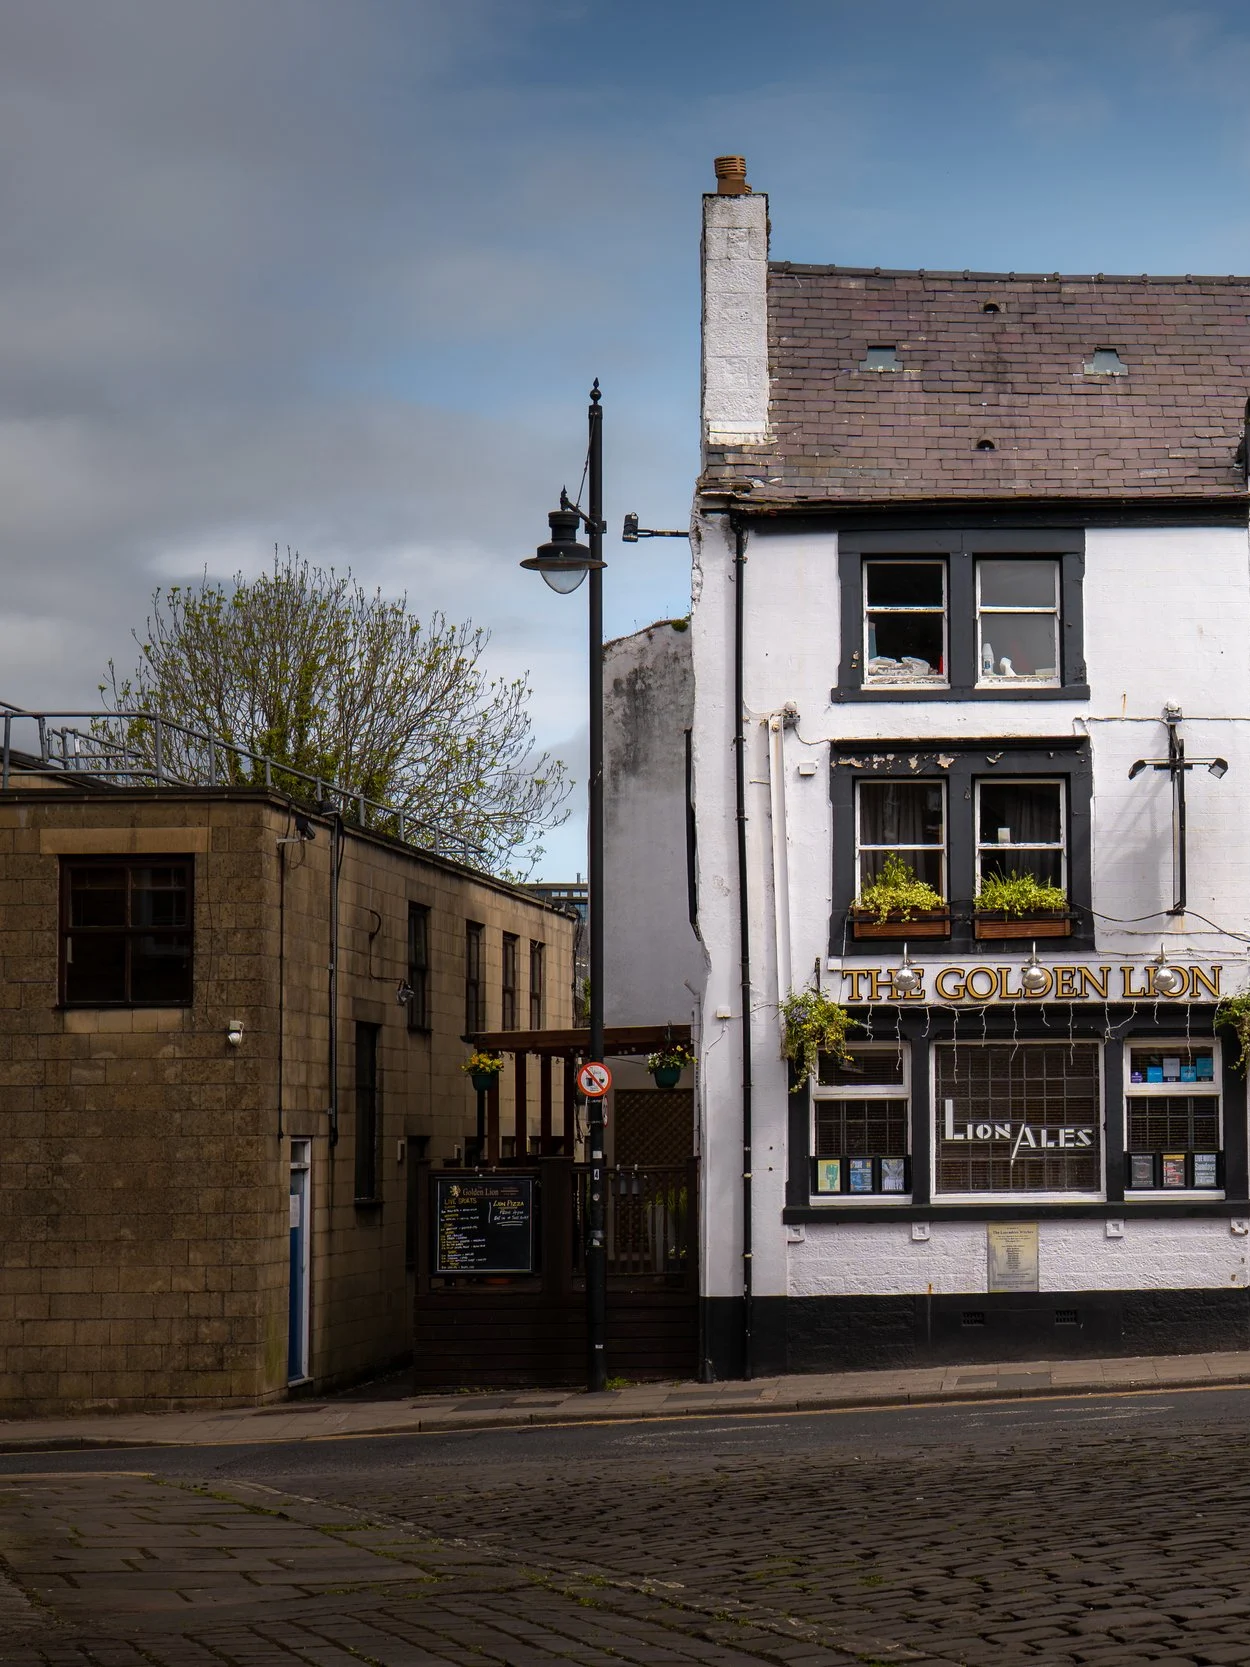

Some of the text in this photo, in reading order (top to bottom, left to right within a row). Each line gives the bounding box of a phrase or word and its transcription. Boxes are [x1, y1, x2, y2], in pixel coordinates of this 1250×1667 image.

[935, 966, 1111, 1000] GOLDEN
[1120, 965, 1222, 999] LION
[485, 1187, 499, 1196] Lion
